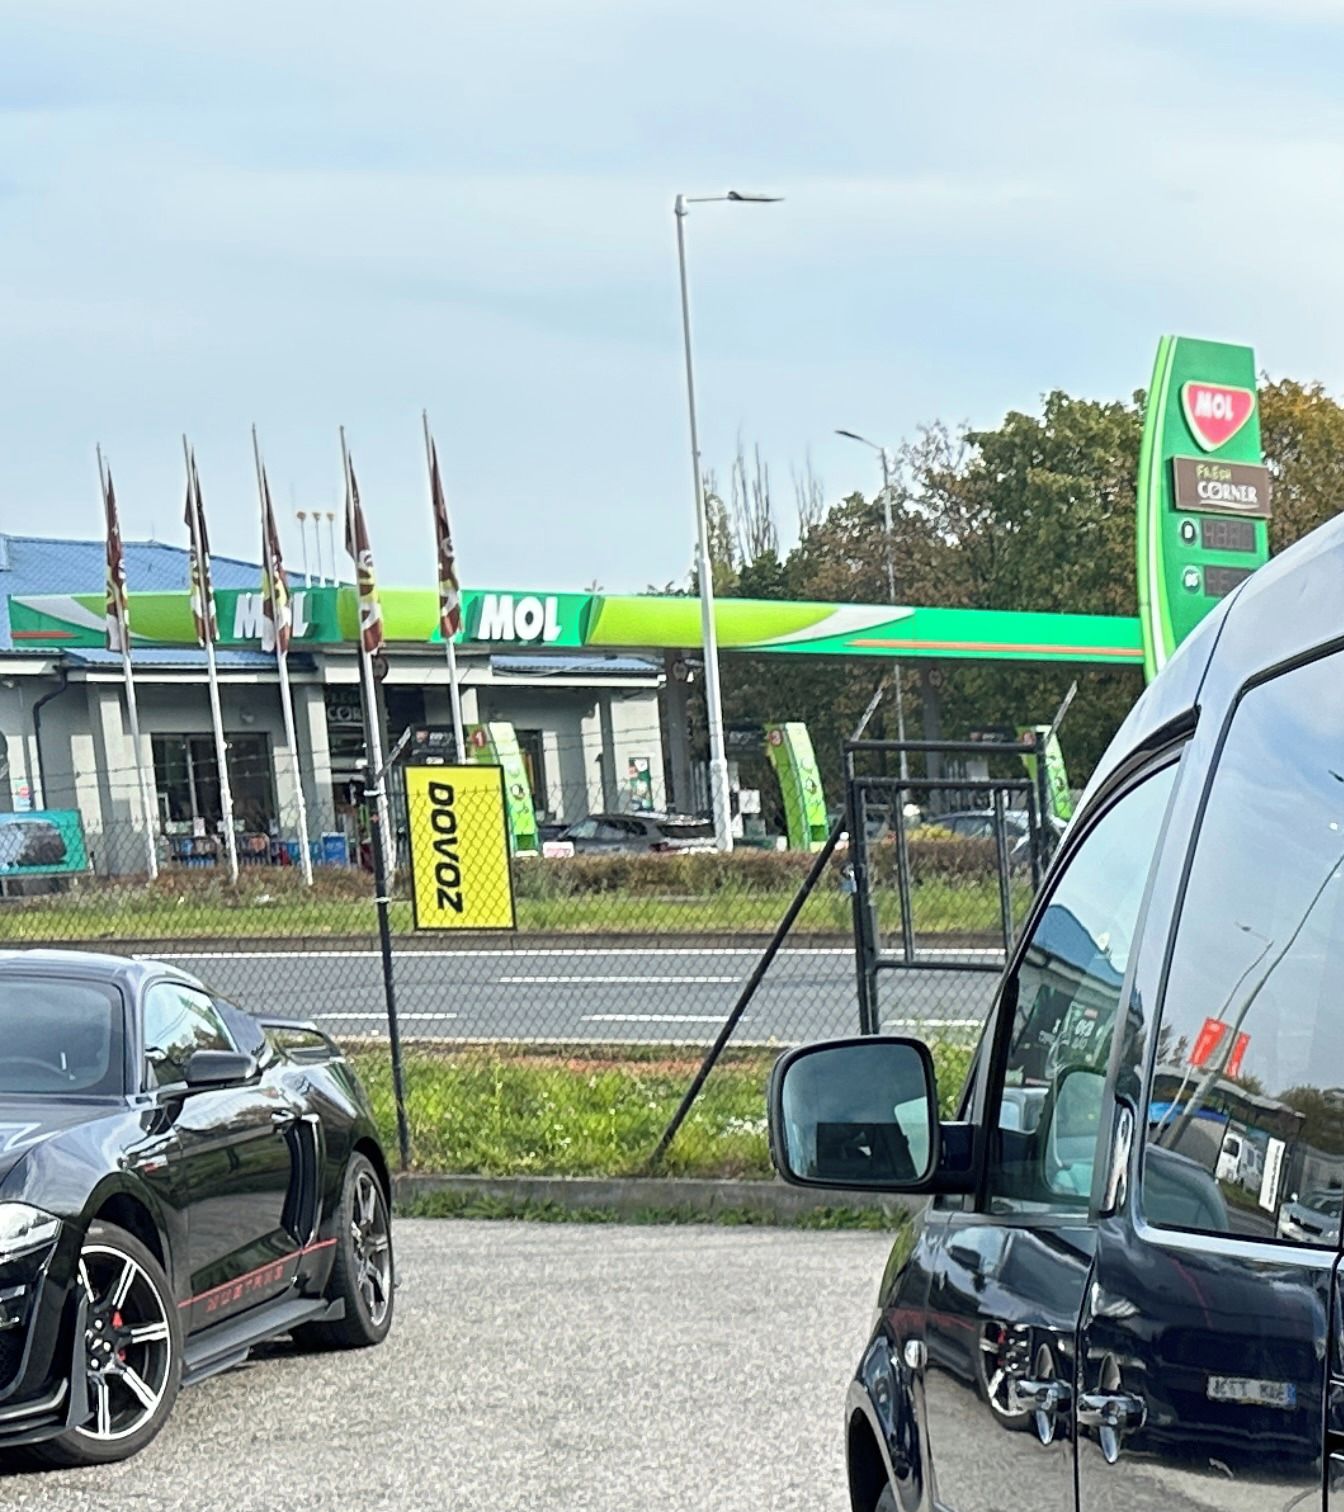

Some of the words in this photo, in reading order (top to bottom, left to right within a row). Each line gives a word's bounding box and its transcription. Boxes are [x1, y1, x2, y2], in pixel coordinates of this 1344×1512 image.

[1195, 390, 1234, 421] MOL
[1197, 481, 1257, 503] CORNER
[233, 592, 309, 639] ML
[477, 595, 562, 642] MOL
[428, 781, 464, 913] DOVOZ
